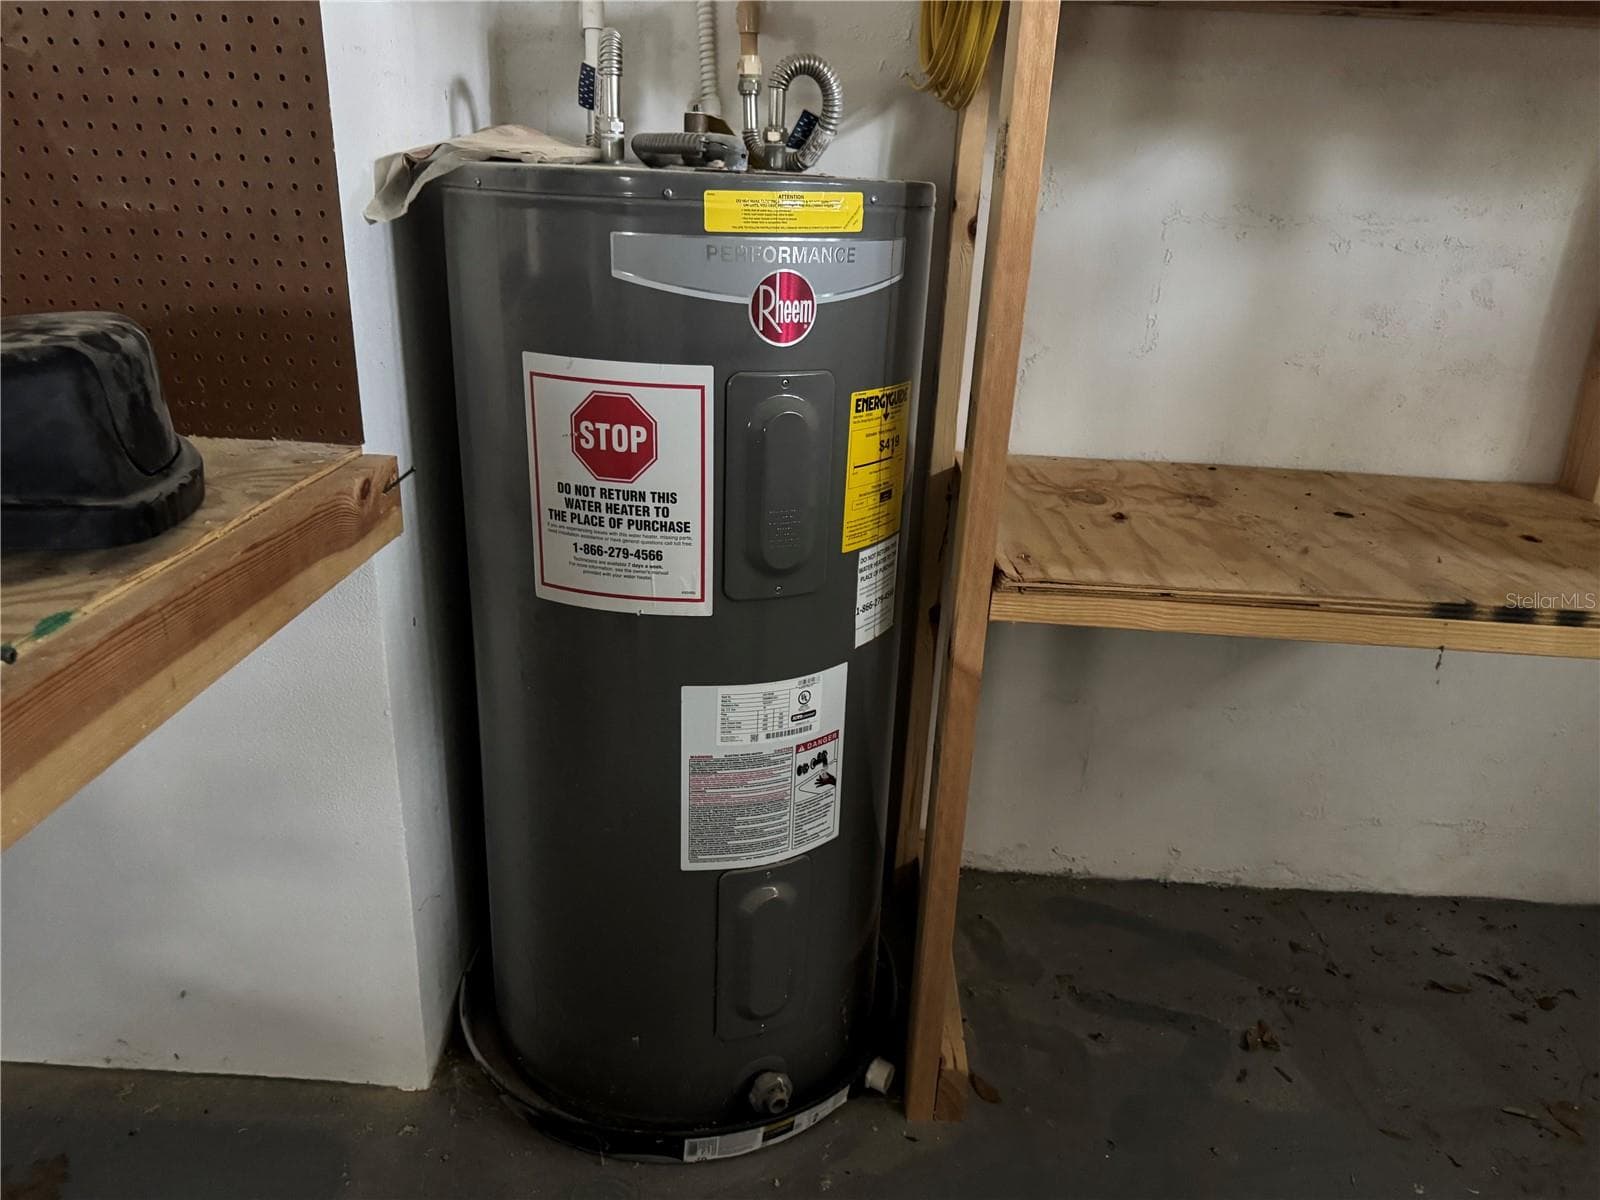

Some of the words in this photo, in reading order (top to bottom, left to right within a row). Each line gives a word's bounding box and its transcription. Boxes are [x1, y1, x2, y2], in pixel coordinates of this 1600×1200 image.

[706, 244, 856, 264] PERFORMANCE
[758, 271, 812, 333] Rheem
[579, 421, 647, 454] STOP
[557, 481, 571, 494] DO
[574, 484, 596, 498] NOT
[600, 487, 646, 503] RETURN
[650, 491, 677, 504] THIS
[564, 497, 601, 513] WATER
[605, 502, 650, 517] HEATER
[654, 506, 669, 518] TO
[548, 508, 567, 522] THE
[570, 512, 605, 528] PLACE
[609, 517, 623, 529] OF
[628, 519, 691, 533] PURCHASE
[572, 542, 663, 561] 1-866-279-4566
[806, 732, 837, 750] DANGER
